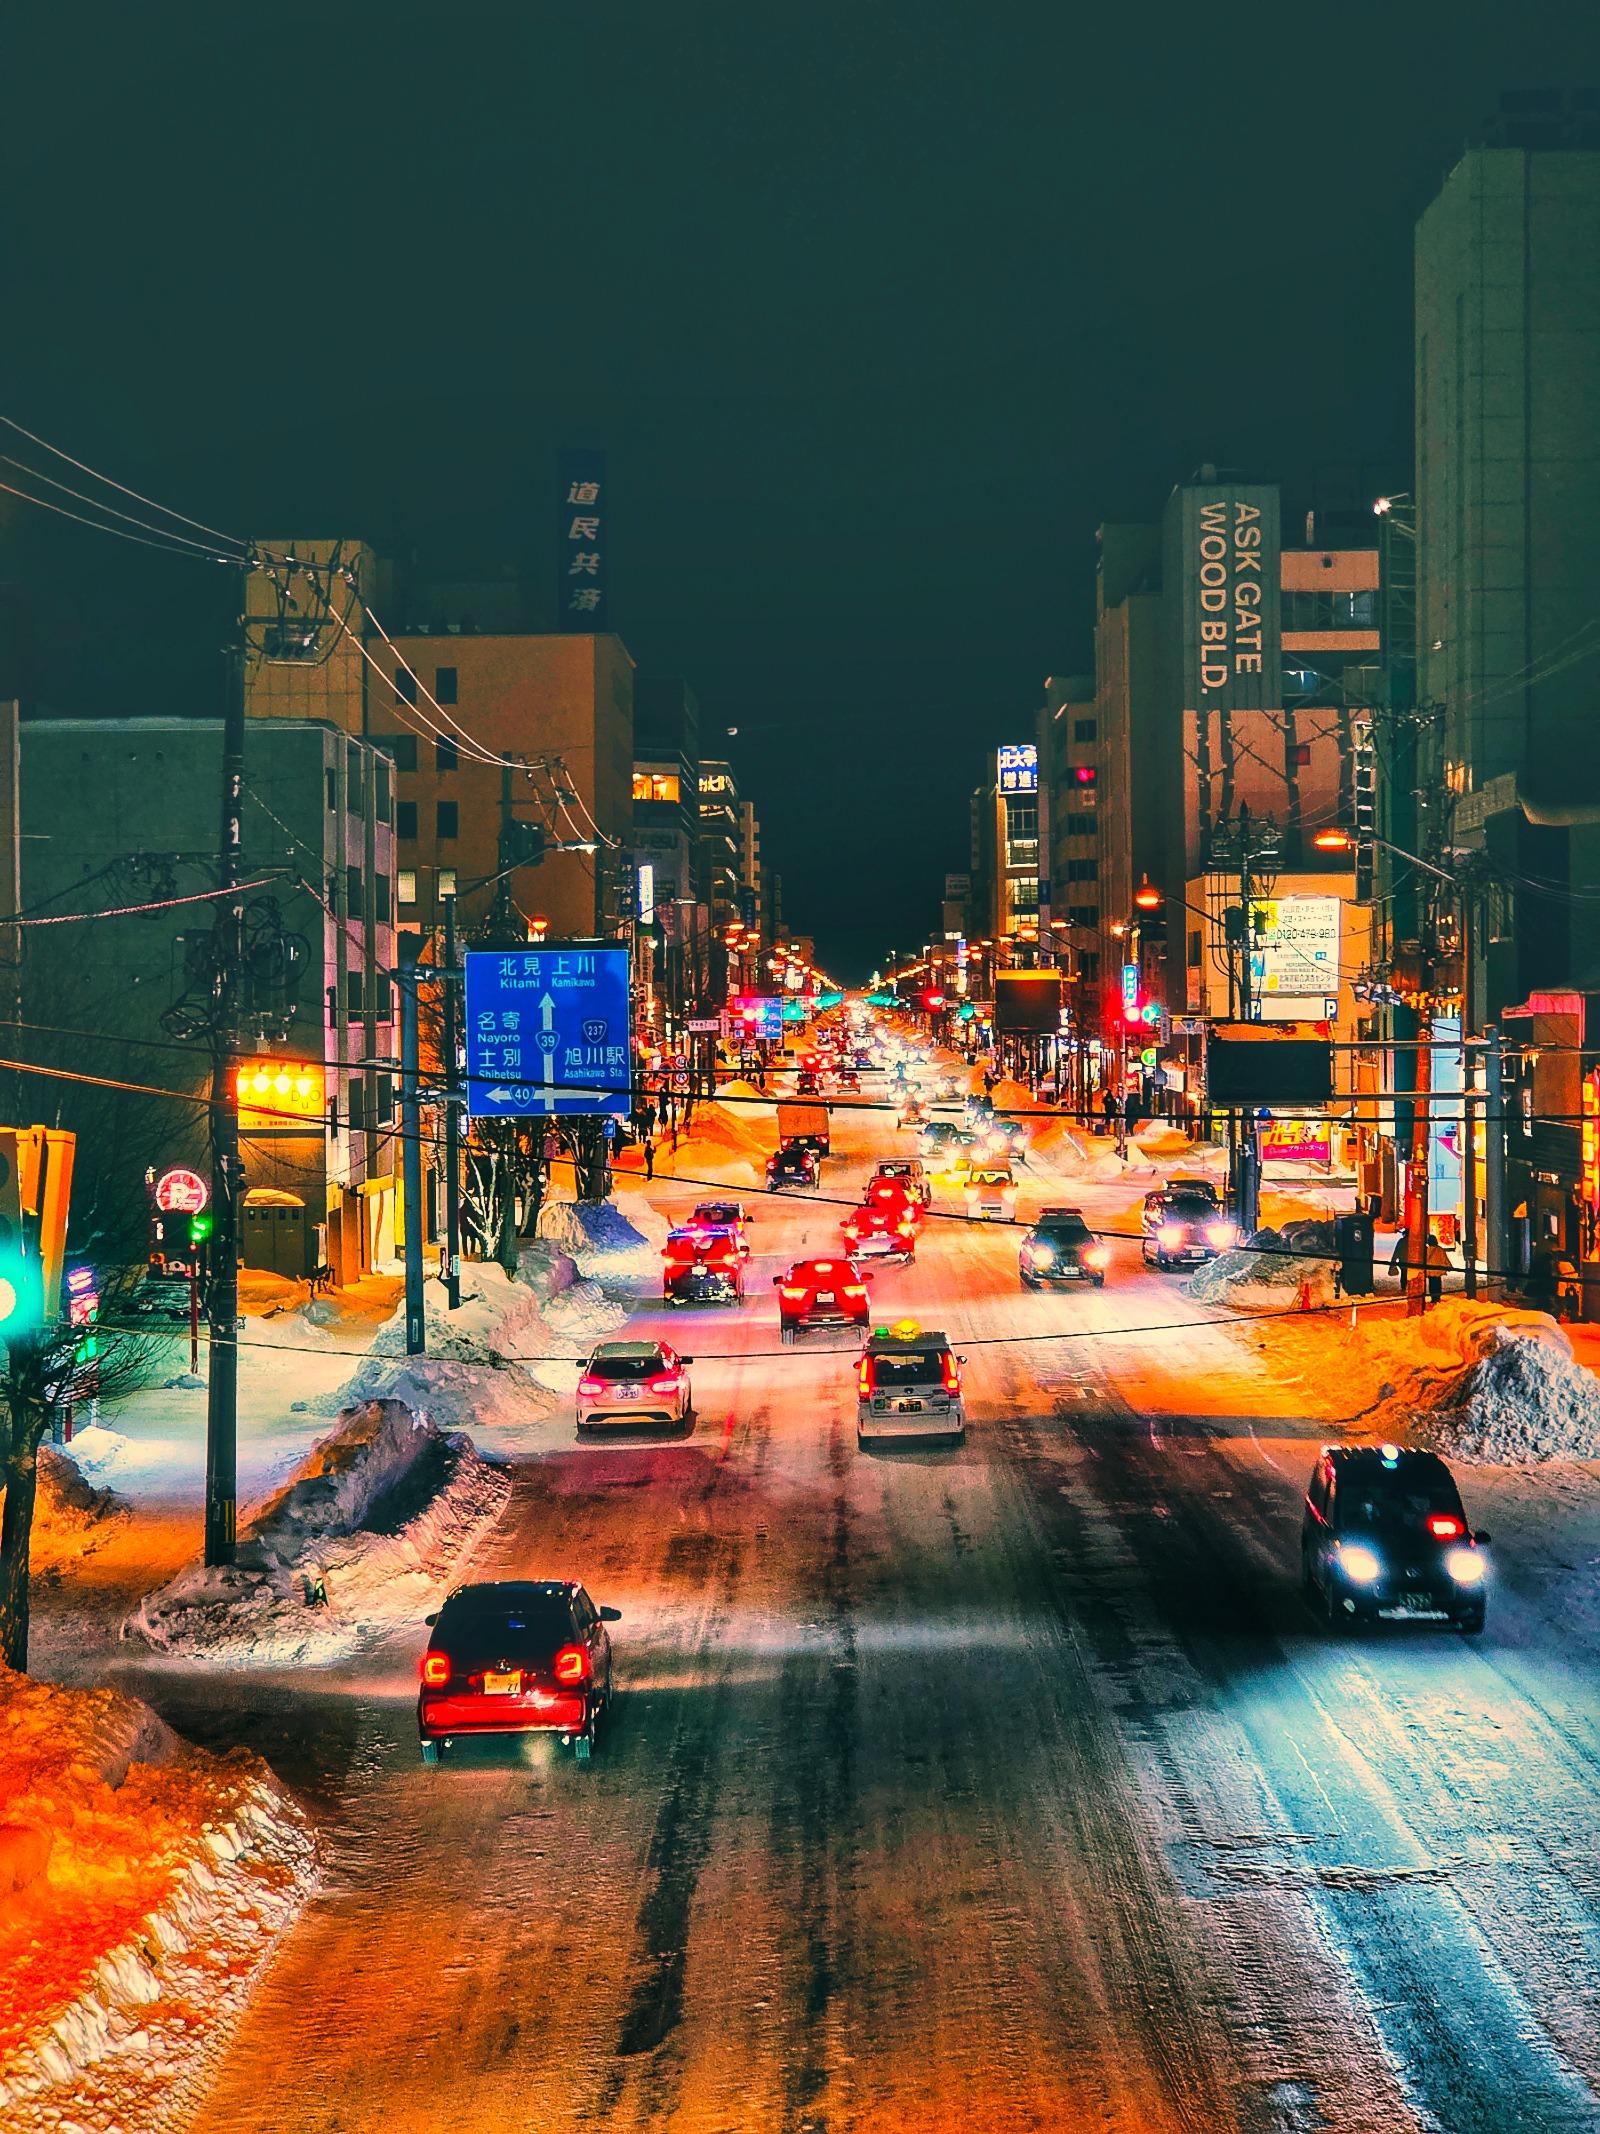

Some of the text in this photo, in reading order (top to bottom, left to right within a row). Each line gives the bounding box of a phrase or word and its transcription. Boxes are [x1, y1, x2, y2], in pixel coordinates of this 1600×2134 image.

[567, 481, 602, 611] 道民共済
[1234, 502, 1262, 674] ASK GATE
[1200, 502, 1228, 694] WOOD BLD.
[499, 956, 595, 976] 北見 上川
[501, 977, 595, 988] Kitami Kamikawa
[1326, 1001, 1337, 1019] P
[477, 1011, 521, 1031] 名寄
[477, 1034, 521, 1045] Nayoro
[588, 1025, 603, 1036] 237
[541, 1035, 555, 1047] 39
[478, 1049, 521, 1067] 士別
[565, 1047, 626, 1065] 旭川駅
[478, 1069, 521, 1080] Shibetsu
[564, 1067, 625, 1079] Asahikawa Sta.
[515, 1088, 530, 1099] 40
